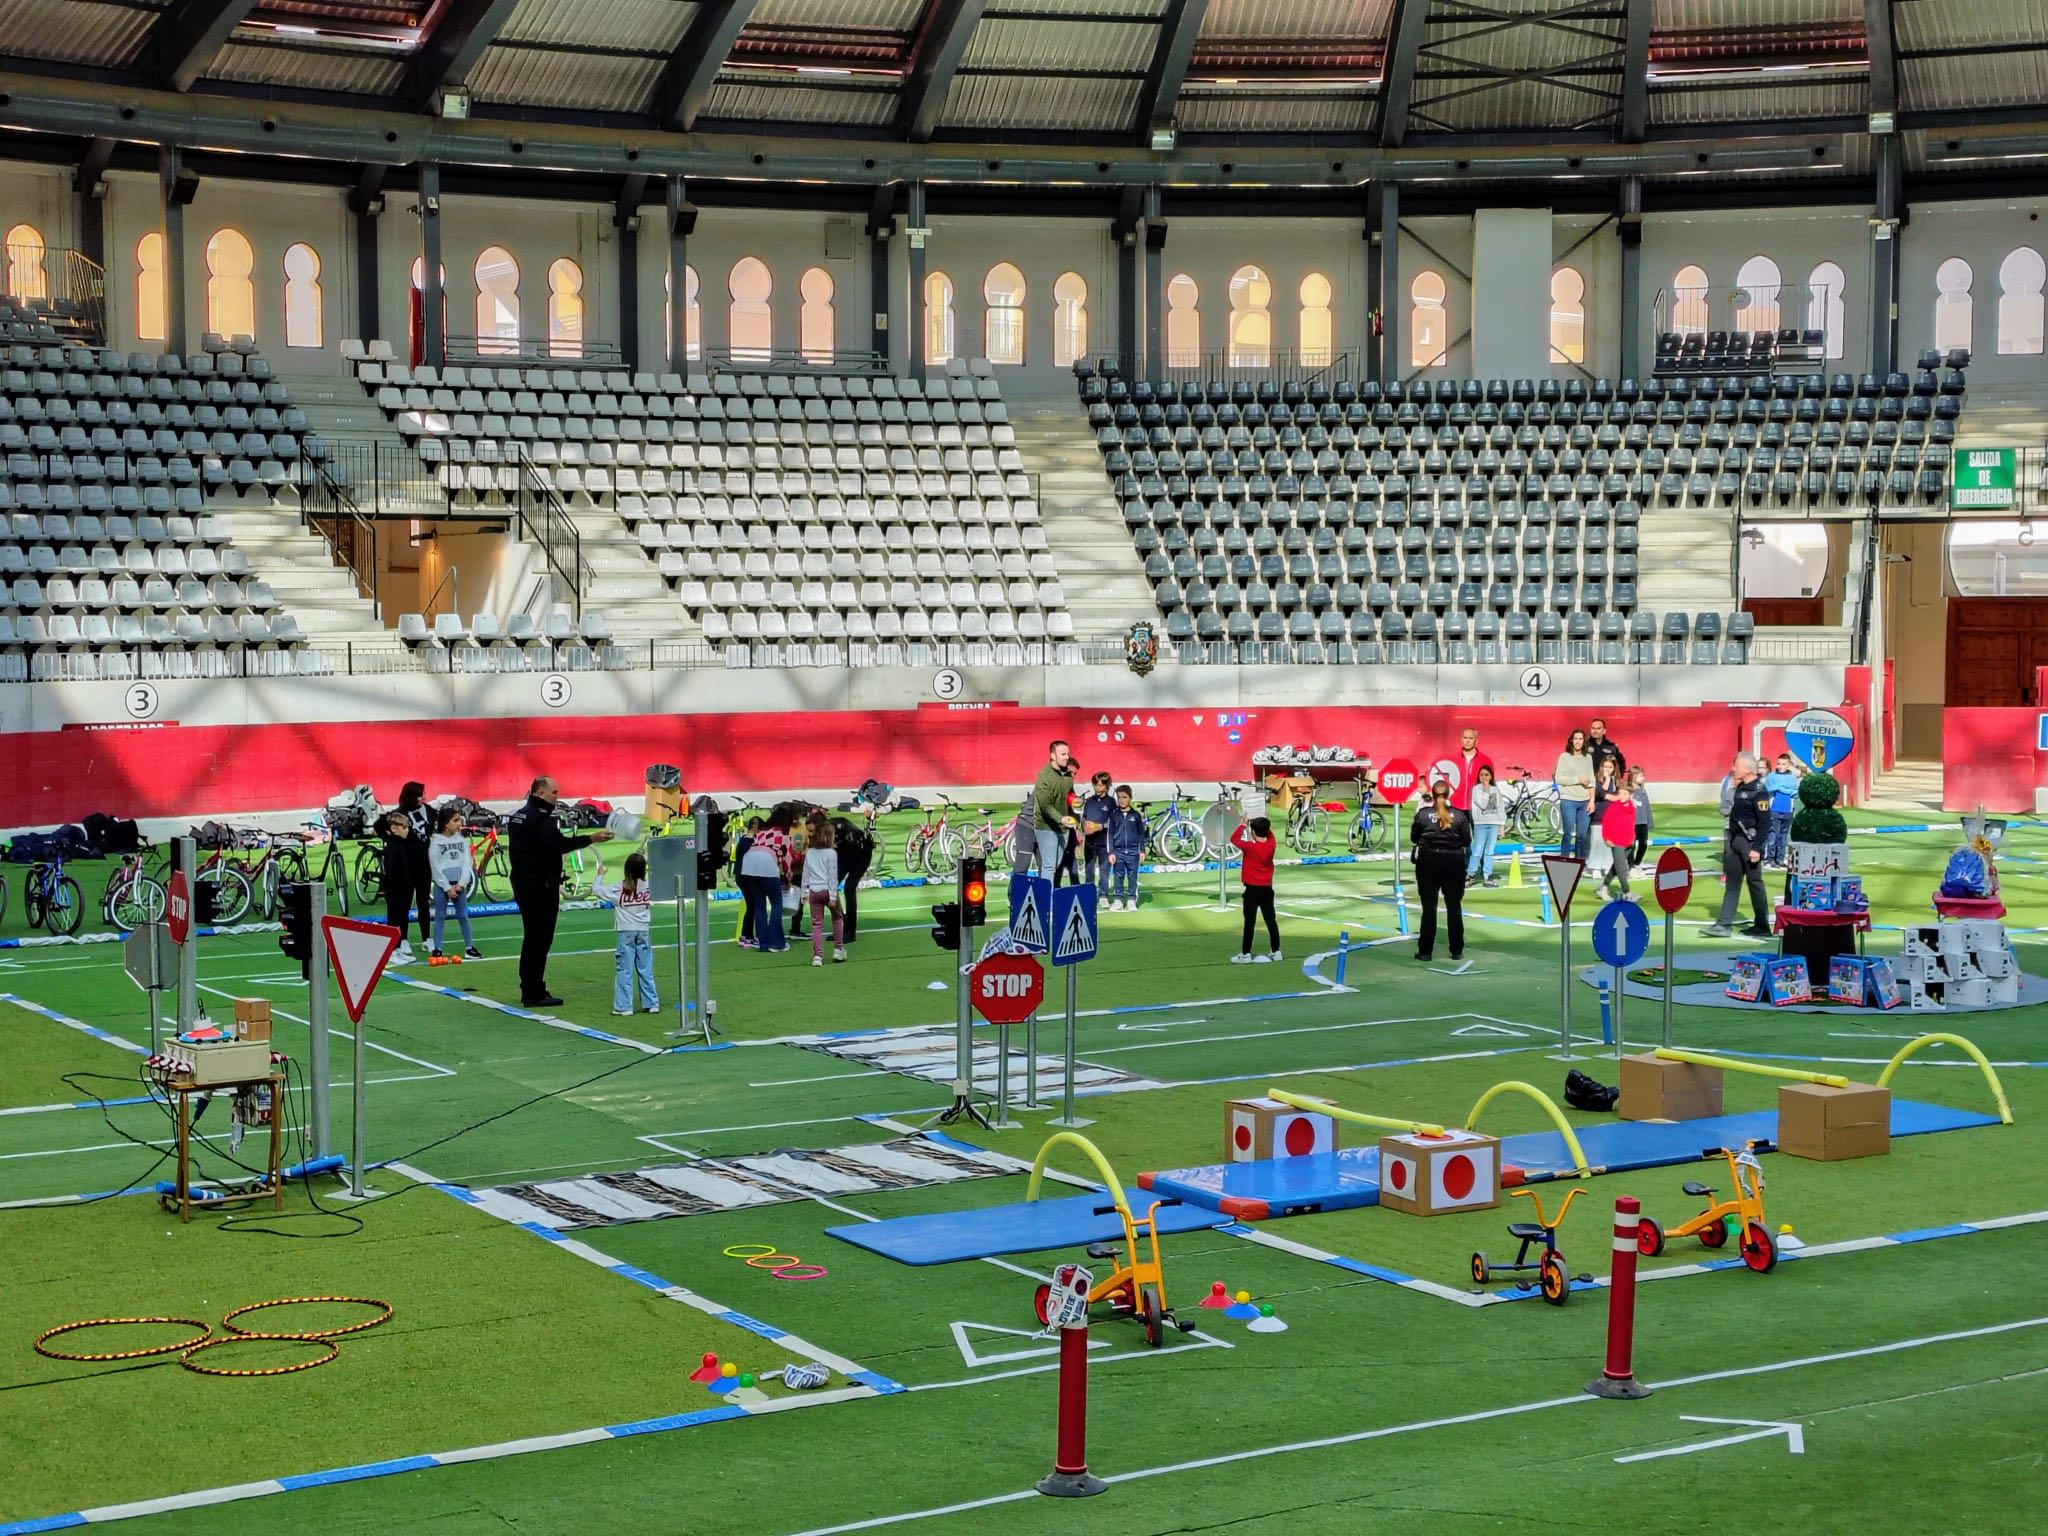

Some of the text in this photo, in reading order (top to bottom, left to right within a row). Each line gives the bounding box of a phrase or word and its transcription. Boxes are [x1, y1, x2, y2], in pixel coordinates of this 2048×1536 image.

[1969, 451, 2001, 467] SALIDA
[1978, 470, 1991, 486] DE
[1956, 489, 2013, 504] EMERGENCIA
[549, 681, 563, 700] 3
[941, 675, 955, 693] 3
[1527, 673, 1543, 691] 4
[134, 690, 149, 711] 3
[1801, 725, 1838, 735] VILLENA
[1383, 773, 1415, 788] STOP
[171, 894, 187, 921] STOP
[982, 974, 1033, 998] STOP
